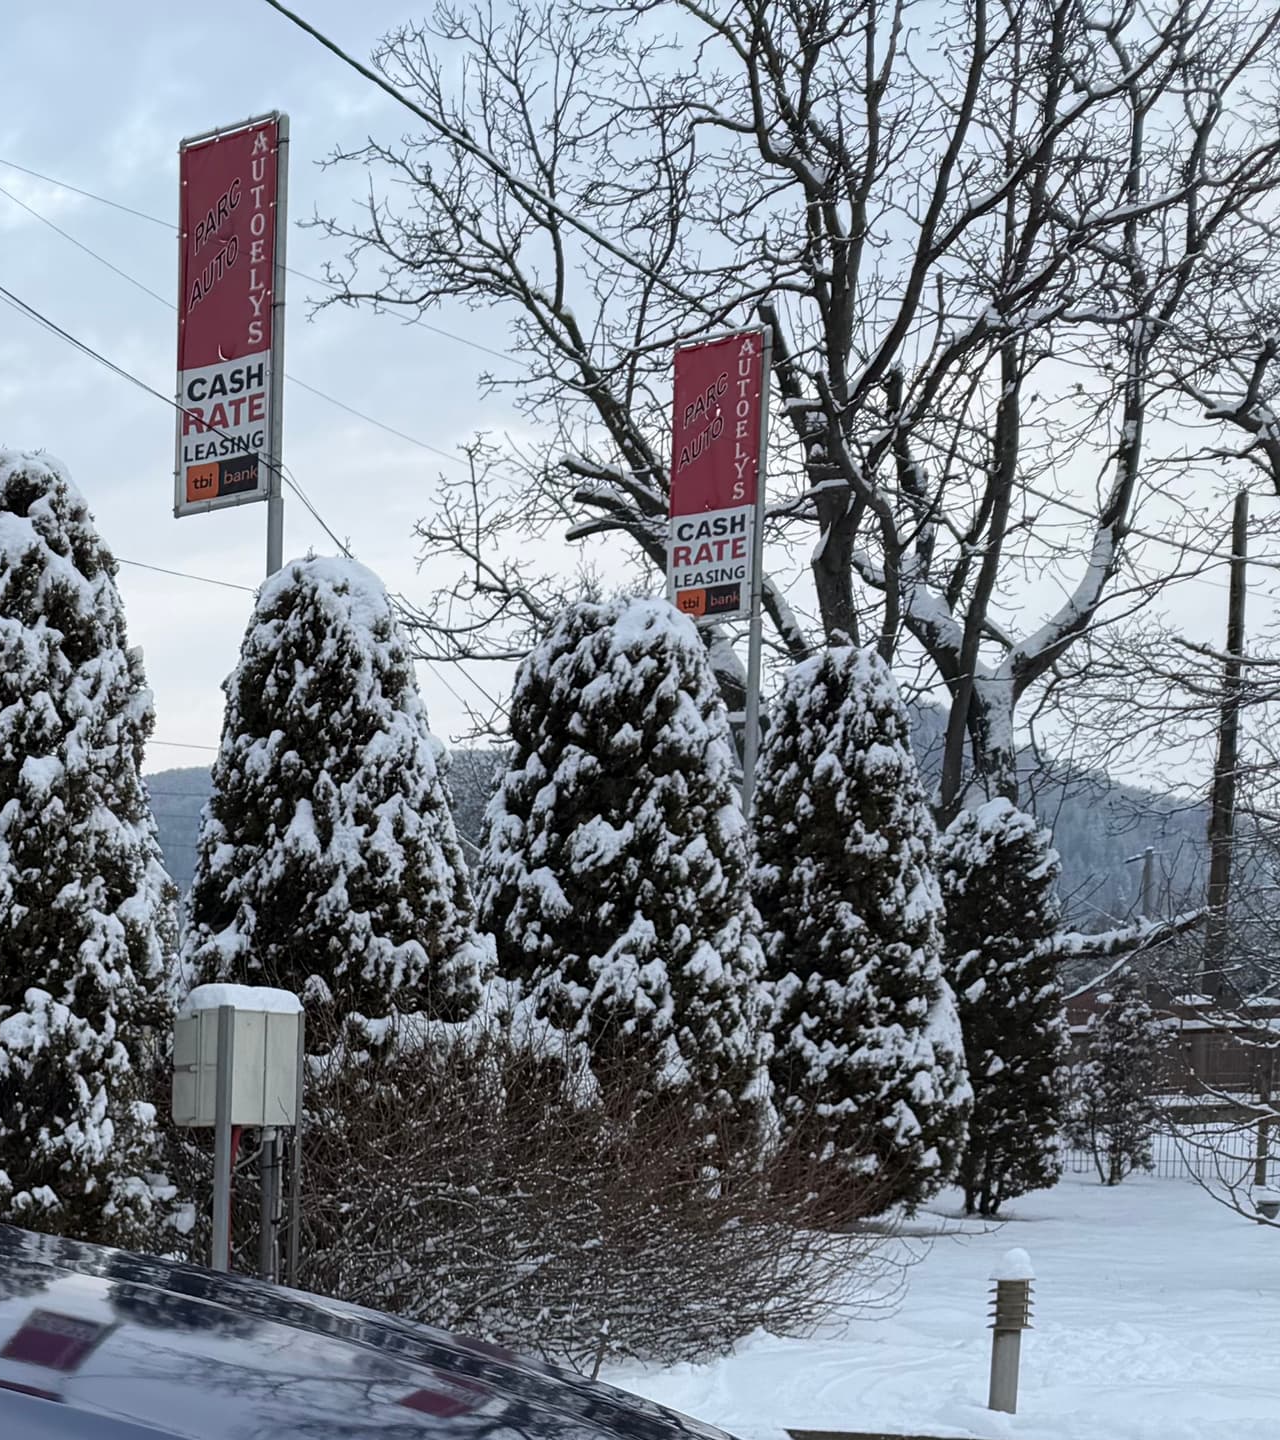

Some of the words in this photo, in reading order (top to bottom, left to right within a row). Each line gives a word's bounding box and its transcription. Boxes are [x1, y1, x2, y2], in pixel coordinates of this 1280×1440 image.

[193, 176, 243, 256] PARC
[247, 130, 269, 345] AUTOELYS
[187, 234, 239, 314] AUTO
[186, 361, 265, 400] CASH
[682, 371, 729, 430] PARC
[181, 391, 266, 437] RATE
[732, 337, 756, 500] AUTOELYS
[183, 428, 265, 463] LEASING
[677, 415, 725, 473] AUTO
[192, 469, 213, 490] tbi
[223, 464, 259, 485] bank
[676, 513, 746, 543] CASH
[672, 536, 747, 569] RATE
[673, 565, 746, 589] LEASING
[681, 594, 700, 611] tbi
